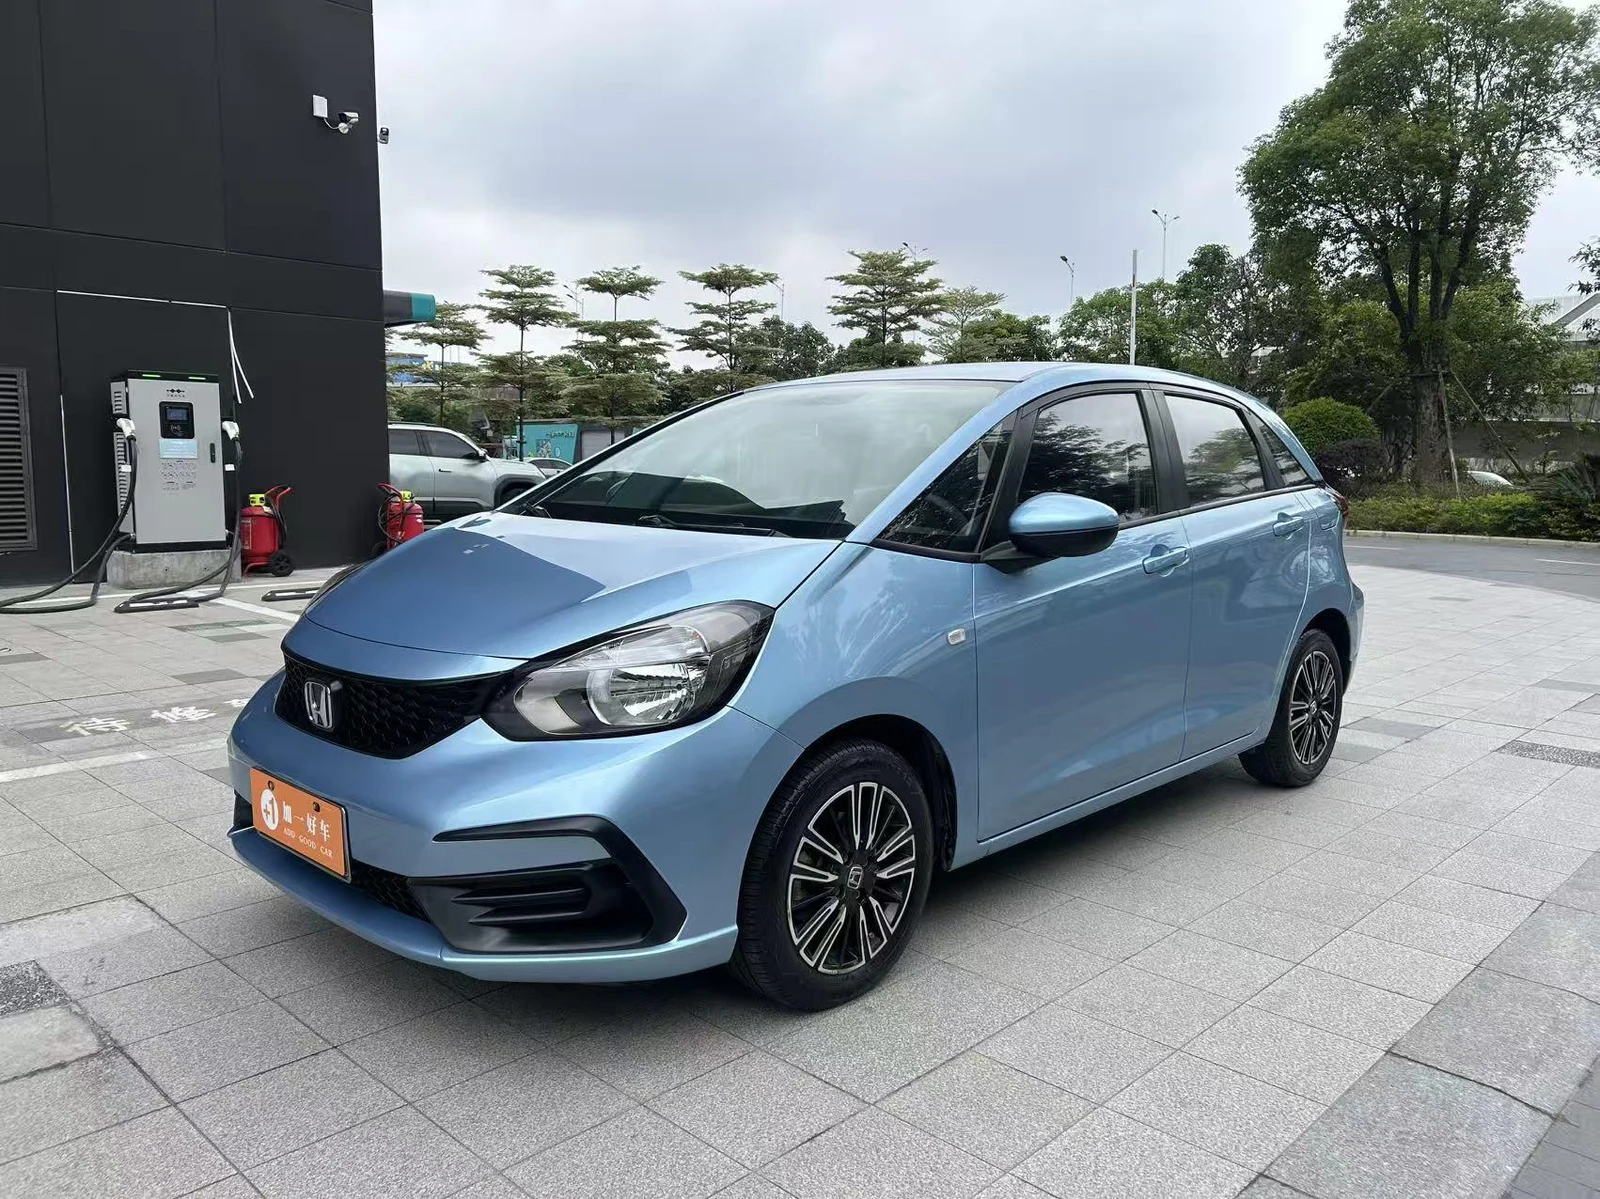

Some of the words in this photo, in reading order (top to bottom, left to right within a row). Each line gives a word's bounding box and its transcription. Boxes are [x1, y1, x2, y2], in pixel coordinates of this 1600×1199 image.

[283, 827, 296, 839] ADD
[298, 834, 317, 850] GOOD
[320, 845, 333, 858] CAR
